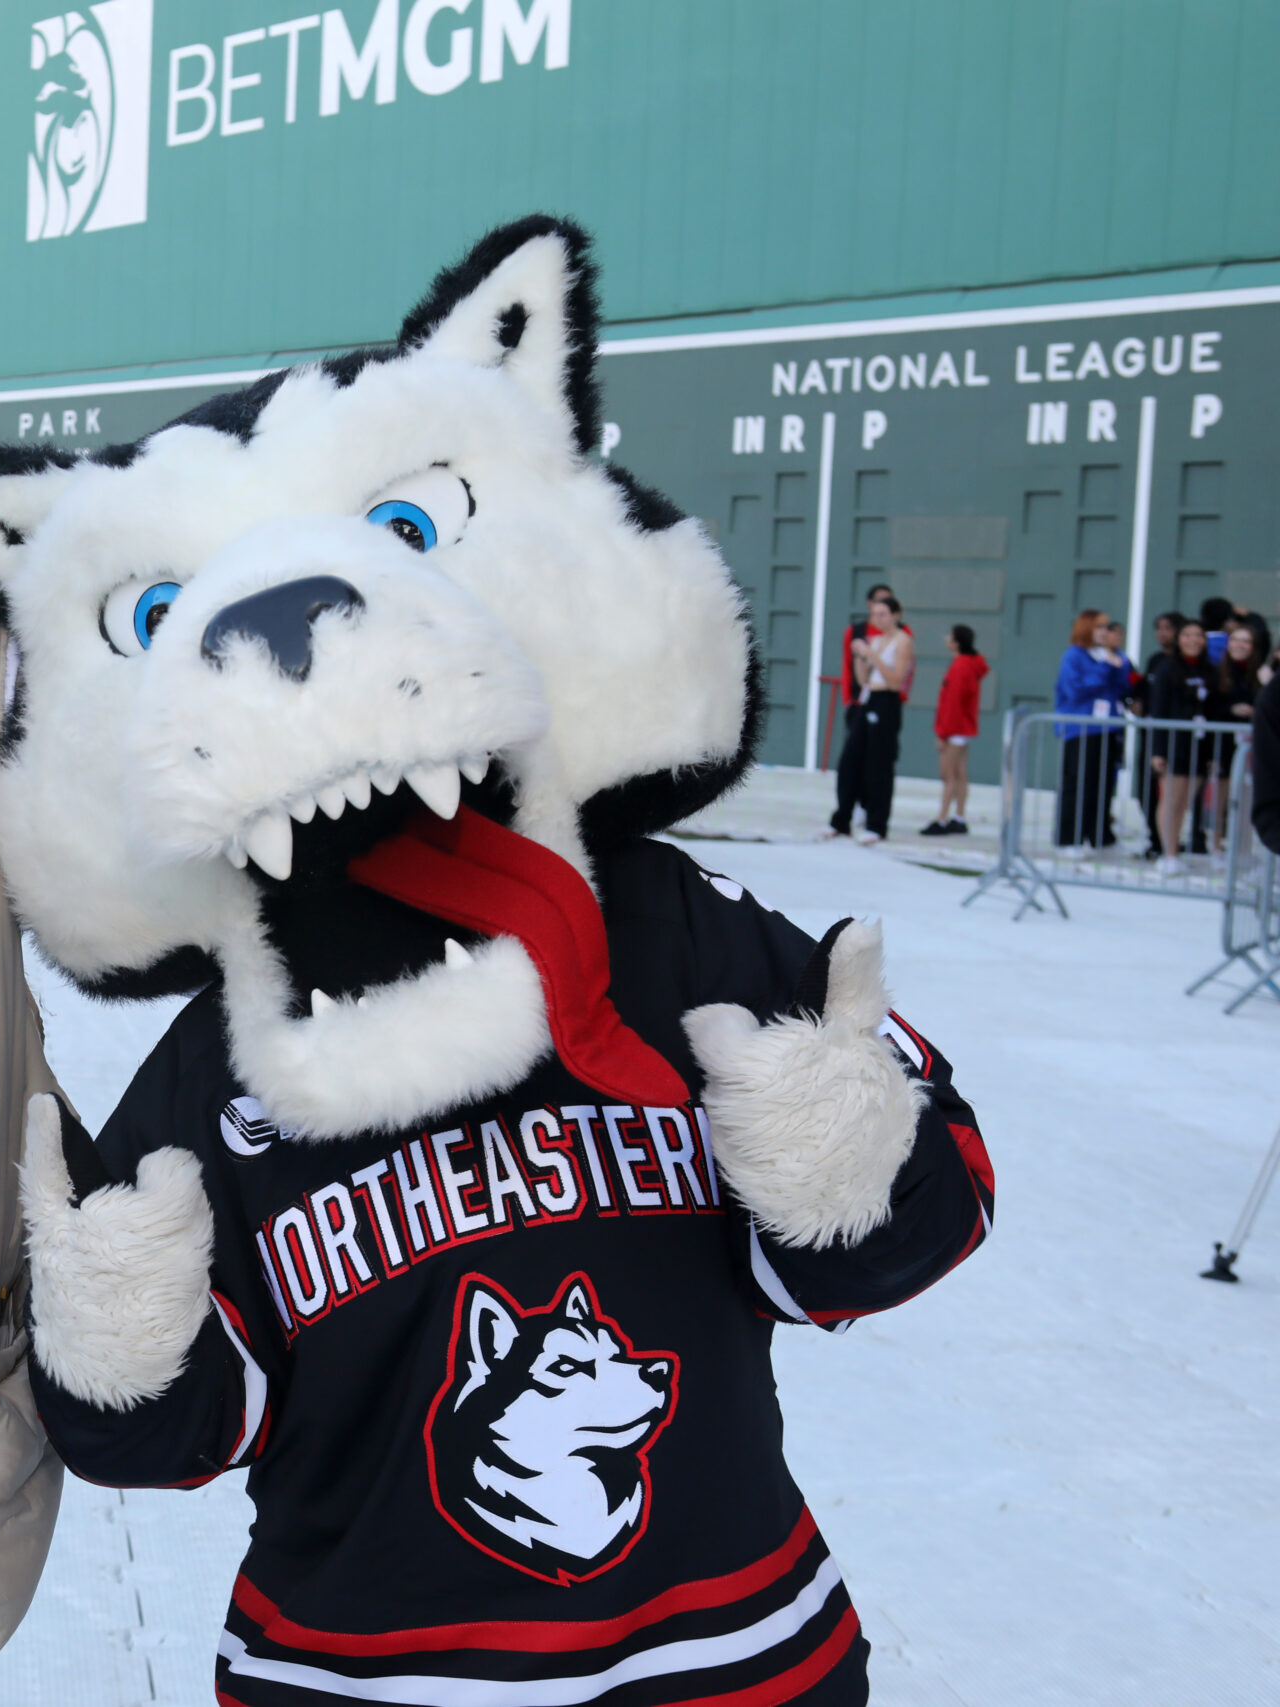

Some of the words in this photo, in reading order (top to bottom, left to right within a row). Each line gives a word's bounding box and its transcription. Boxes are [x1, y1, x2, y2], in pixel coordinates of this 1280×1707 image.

[166, 0, 572, 147] BETMGM
[771, 348, 990, 397] NATIONAL
[1014, 331, 1222, 384] LEAGUE
[19, 407, 102, 438] PARK
[732, 415, 765, 455] IN
[780, 412, 806, 453] R
[861, 410, 888, 450] P
[1026, 401, 1068, 445] IN
[1086, 398, 1118, 442] R
[1190, 393, 1224, 438] P
[601, 421, 622, 458] P
